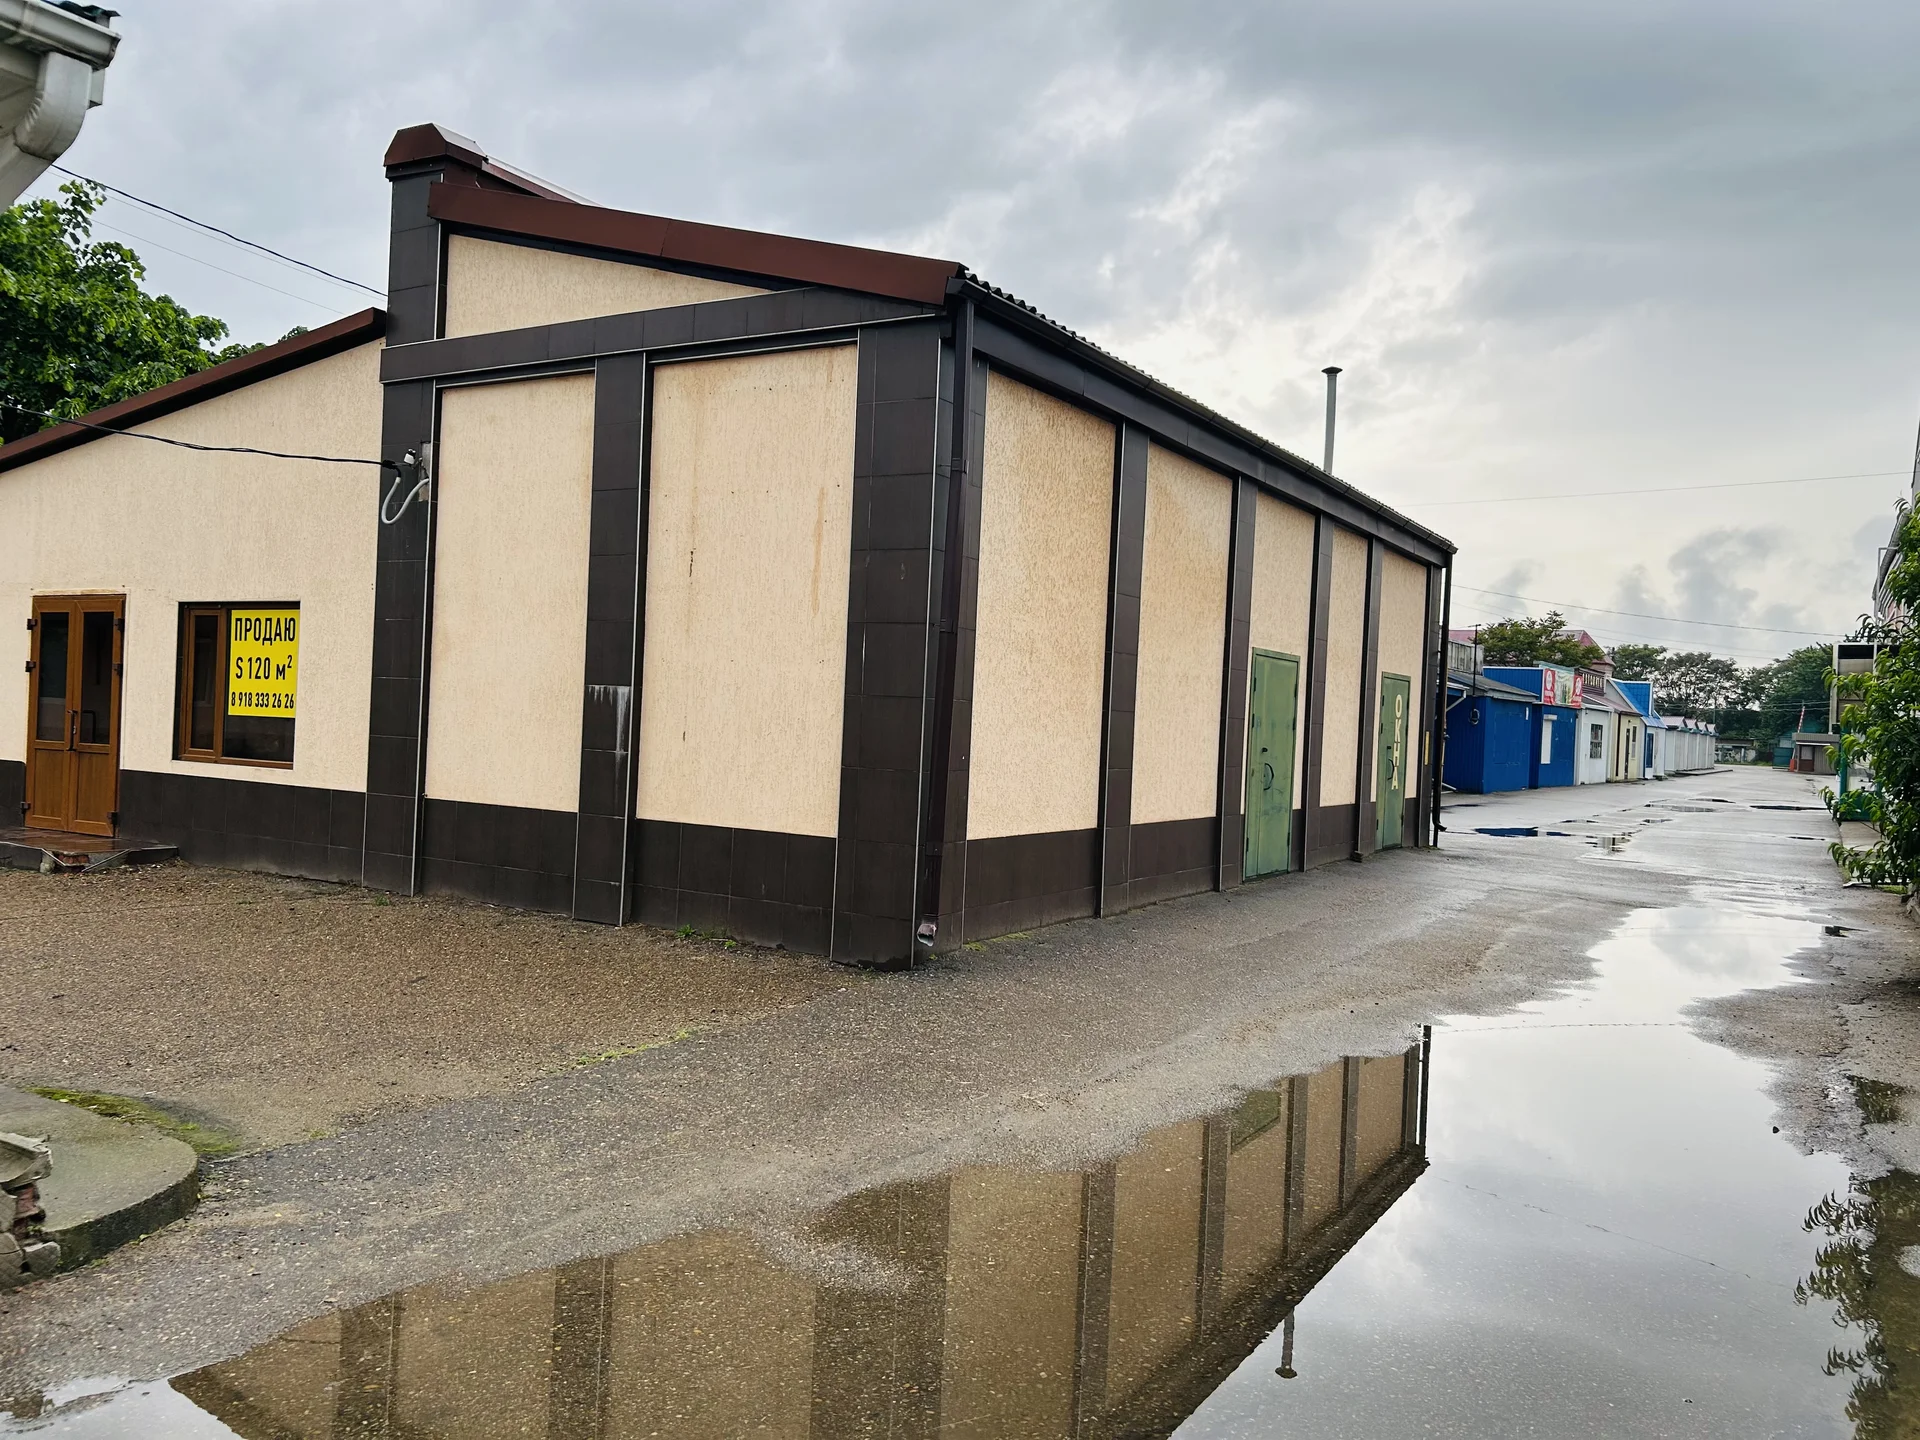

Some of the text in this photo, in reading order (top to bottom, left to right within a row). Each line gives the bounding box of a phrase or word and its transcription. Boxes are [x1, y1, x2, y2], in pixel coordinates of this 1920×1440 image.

[235, 618, 296, 646] ПРОДАЮ
[235, 656, 244, 679] S
[247, 657, 271, 680] 120
[231, 691, 295, 709] 8 918 333 26 26
[1391, 694, 1403, 790] ОКНА
